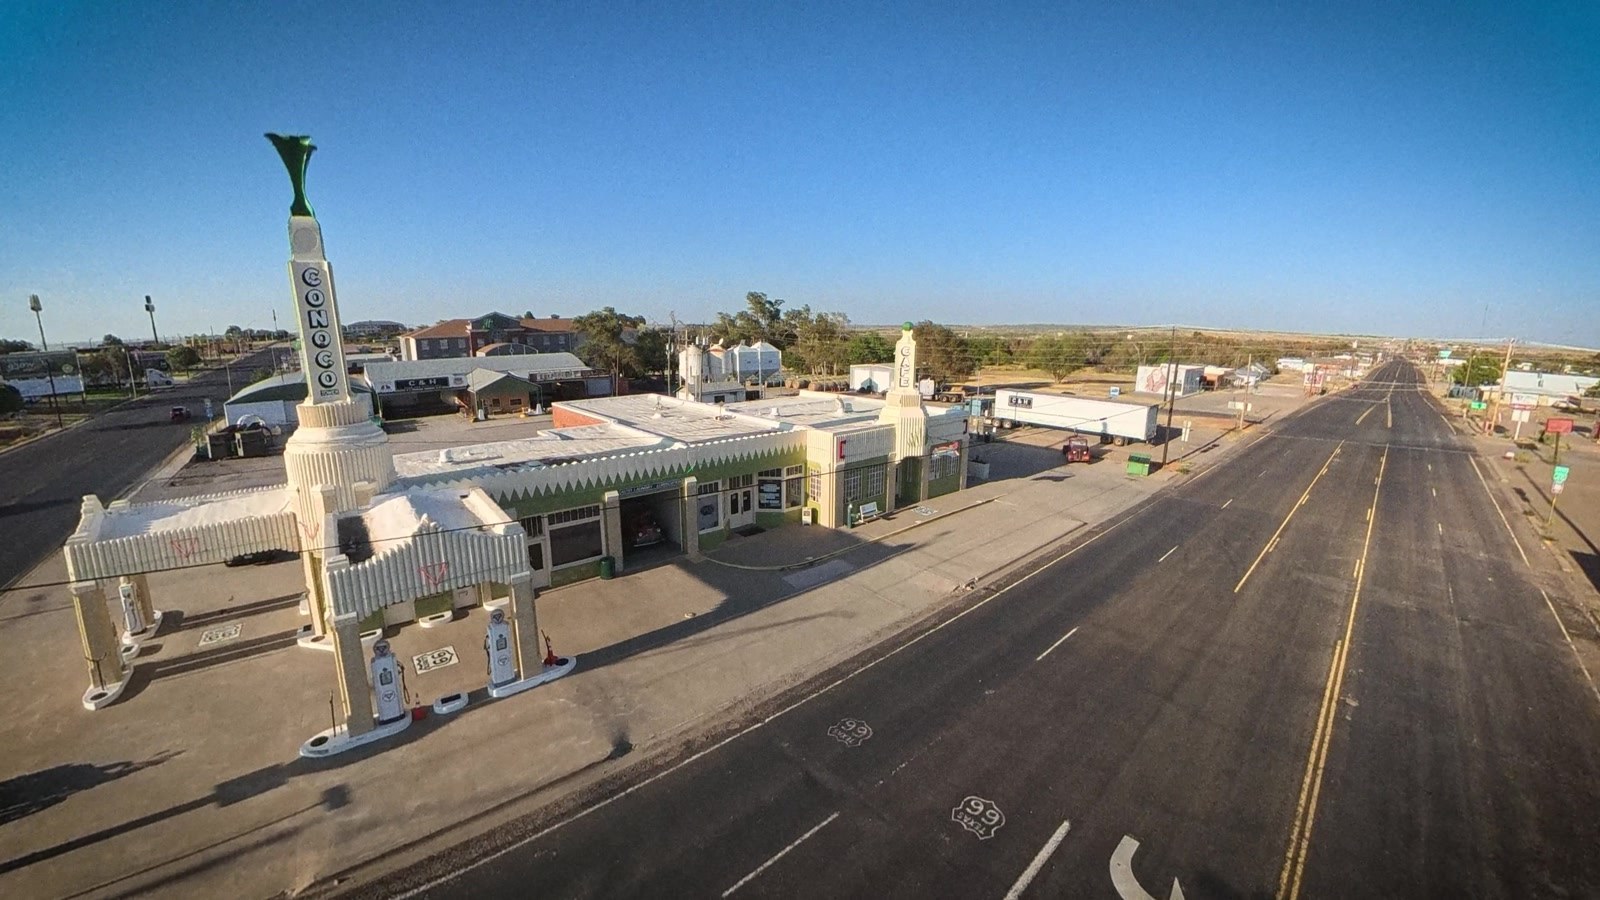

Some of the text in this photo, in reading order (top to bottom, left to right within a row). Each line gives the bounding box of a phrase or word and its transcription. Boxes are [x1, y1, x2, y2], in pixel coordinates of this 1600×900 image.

[302, 267, 337, 388] CONOCO
[899, 346, 911, 388] CAFE
[432, 651, 448, 664] 66
[957, 811, 986, 835] TEXAS
[965, 800, 1000, 825] 66
